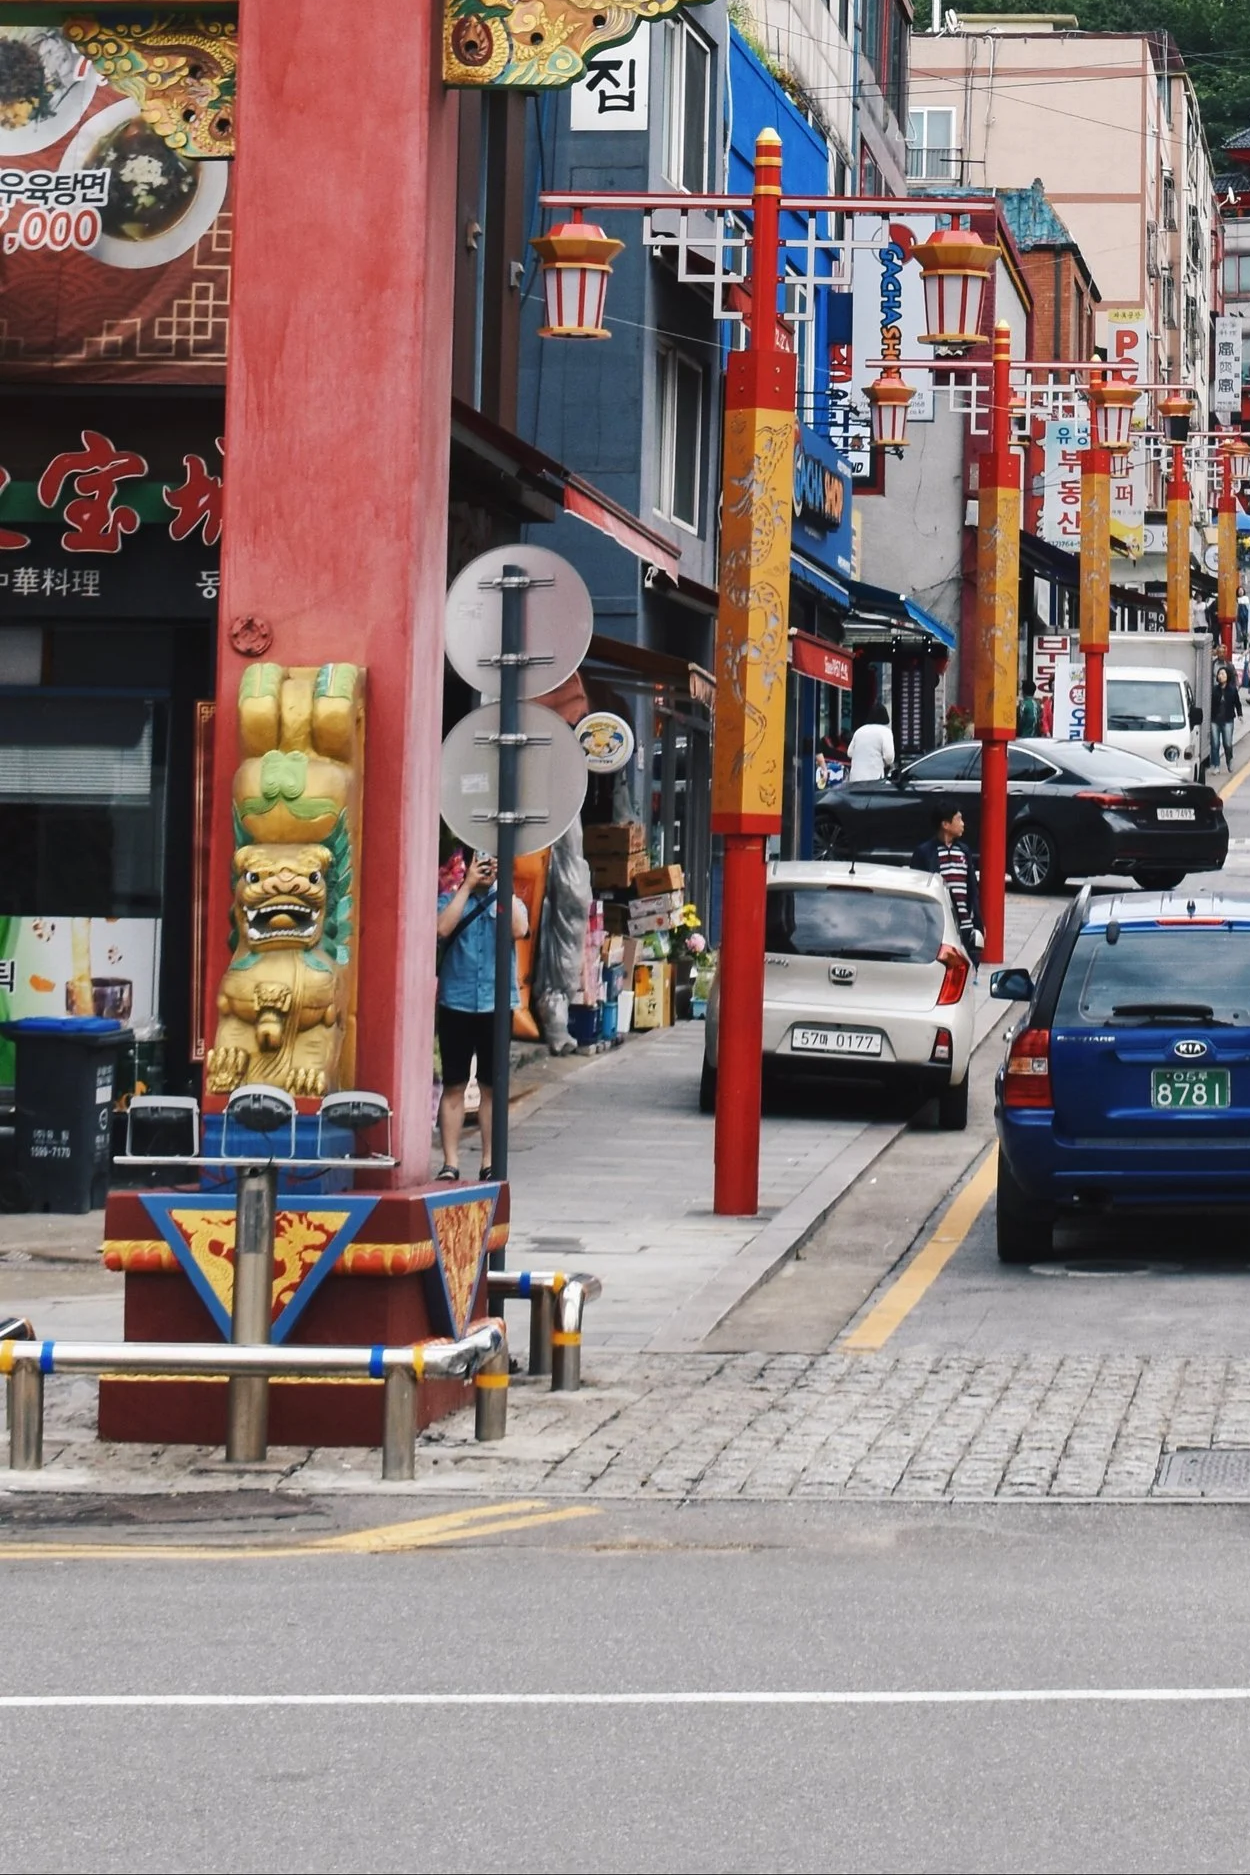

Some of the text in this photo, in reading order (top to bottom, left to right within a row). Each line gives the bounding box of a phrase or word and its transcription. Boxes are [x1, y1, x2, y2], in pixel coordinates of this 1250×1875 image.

[586, 58, 636, 114] 집
[6, 209, 98, 250] ,000
[880, 242, 904, 326] GACHA
[0, 567, 101, 597] 華料理
[836, 1033, 874, 1050] 0177
[1177, 1042, 1204, 1056] KIA
[1156, 1083, 1220, 1106] 8781
